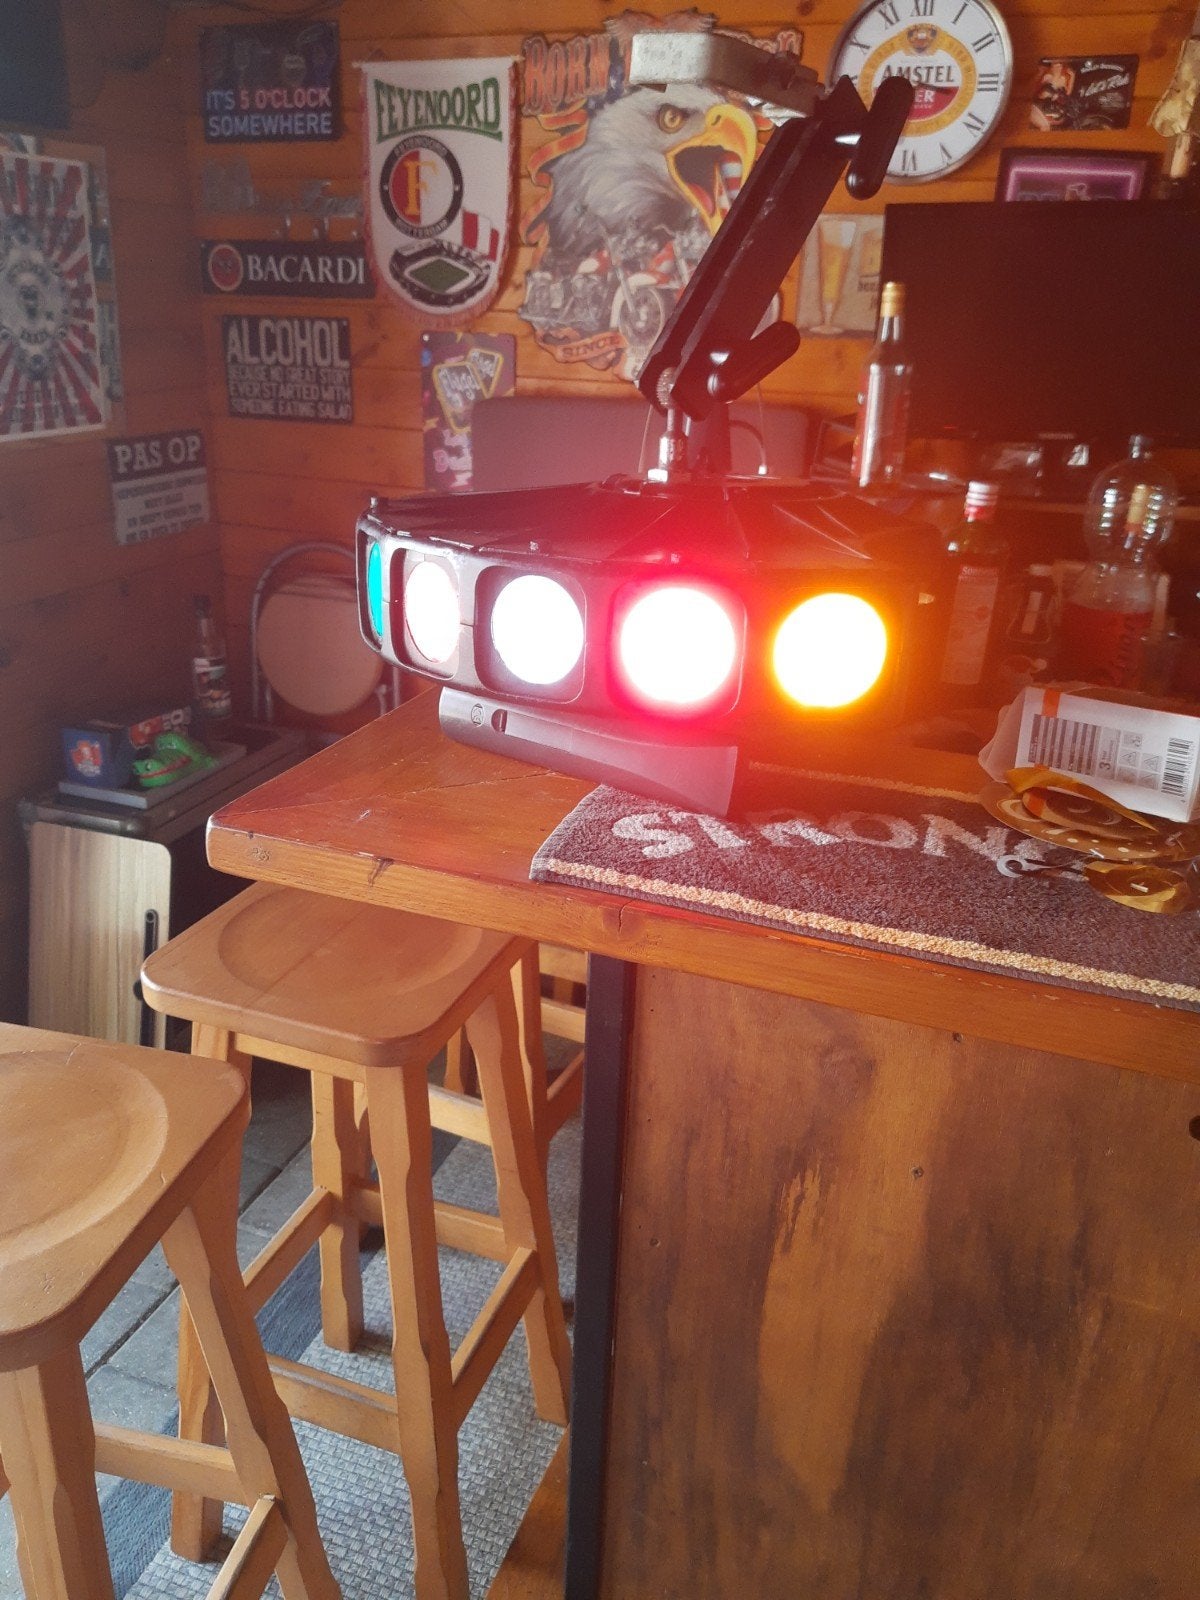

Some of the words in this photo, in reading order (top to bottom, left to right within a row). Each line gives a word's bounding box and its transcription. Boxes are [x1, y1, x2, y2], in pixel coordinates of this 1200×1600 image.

[521, 35, 611, 115] BORN
[882, 65, 955, 84] AMSTEL
[240, 90, 249, 109] 5
[255, 87, 332, 109] O'CLOCK
[374, 77, 503, 143] FEYENOORD
[209, 113, 332, 137] SOMEWHERE
[247, 255, 365, 284] BACARDI
[227, 318, 351, 369] ALCOHOL
[263, 383, 319, 400] STARTED
[321, 384, 351, 401] WITH
[115, 440, 162, 473] PAS
[168, 435, 200, 463] OP
